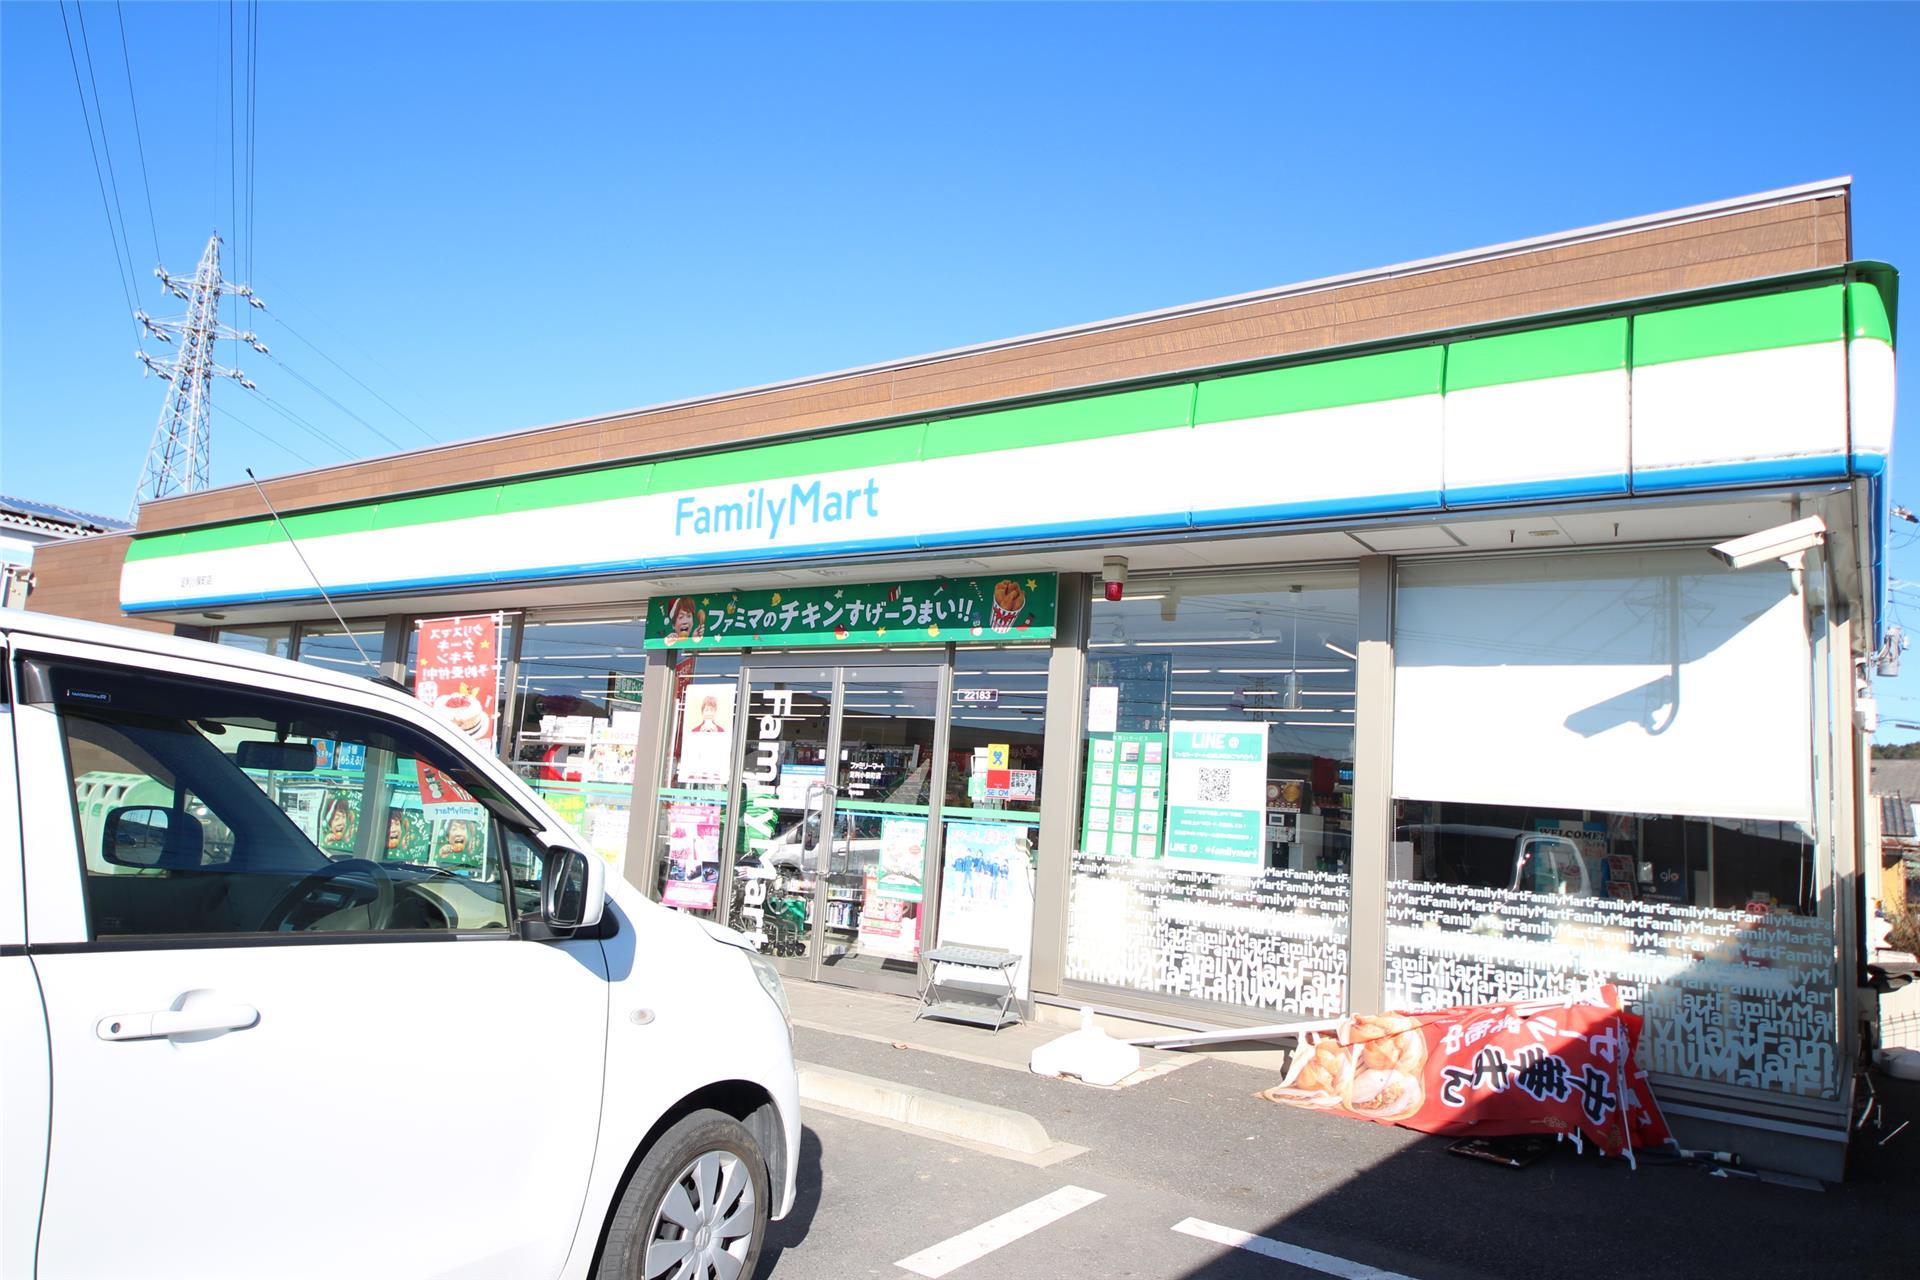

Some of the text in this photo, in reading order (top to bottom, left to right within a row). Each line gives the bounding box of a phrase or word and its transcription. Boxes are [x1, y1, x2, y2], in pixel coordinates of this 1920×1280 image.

[675, 477, 879, 539] FamilyMart
[964, 690, 991, 700] 22183
[1190, 733, 1226, 749] LINE
[1539, 827, 1606, 841] WELCOME!
[1659, 868, 1680, 882] glo
[1441, 1045, 1617, 1124] 中華まん
